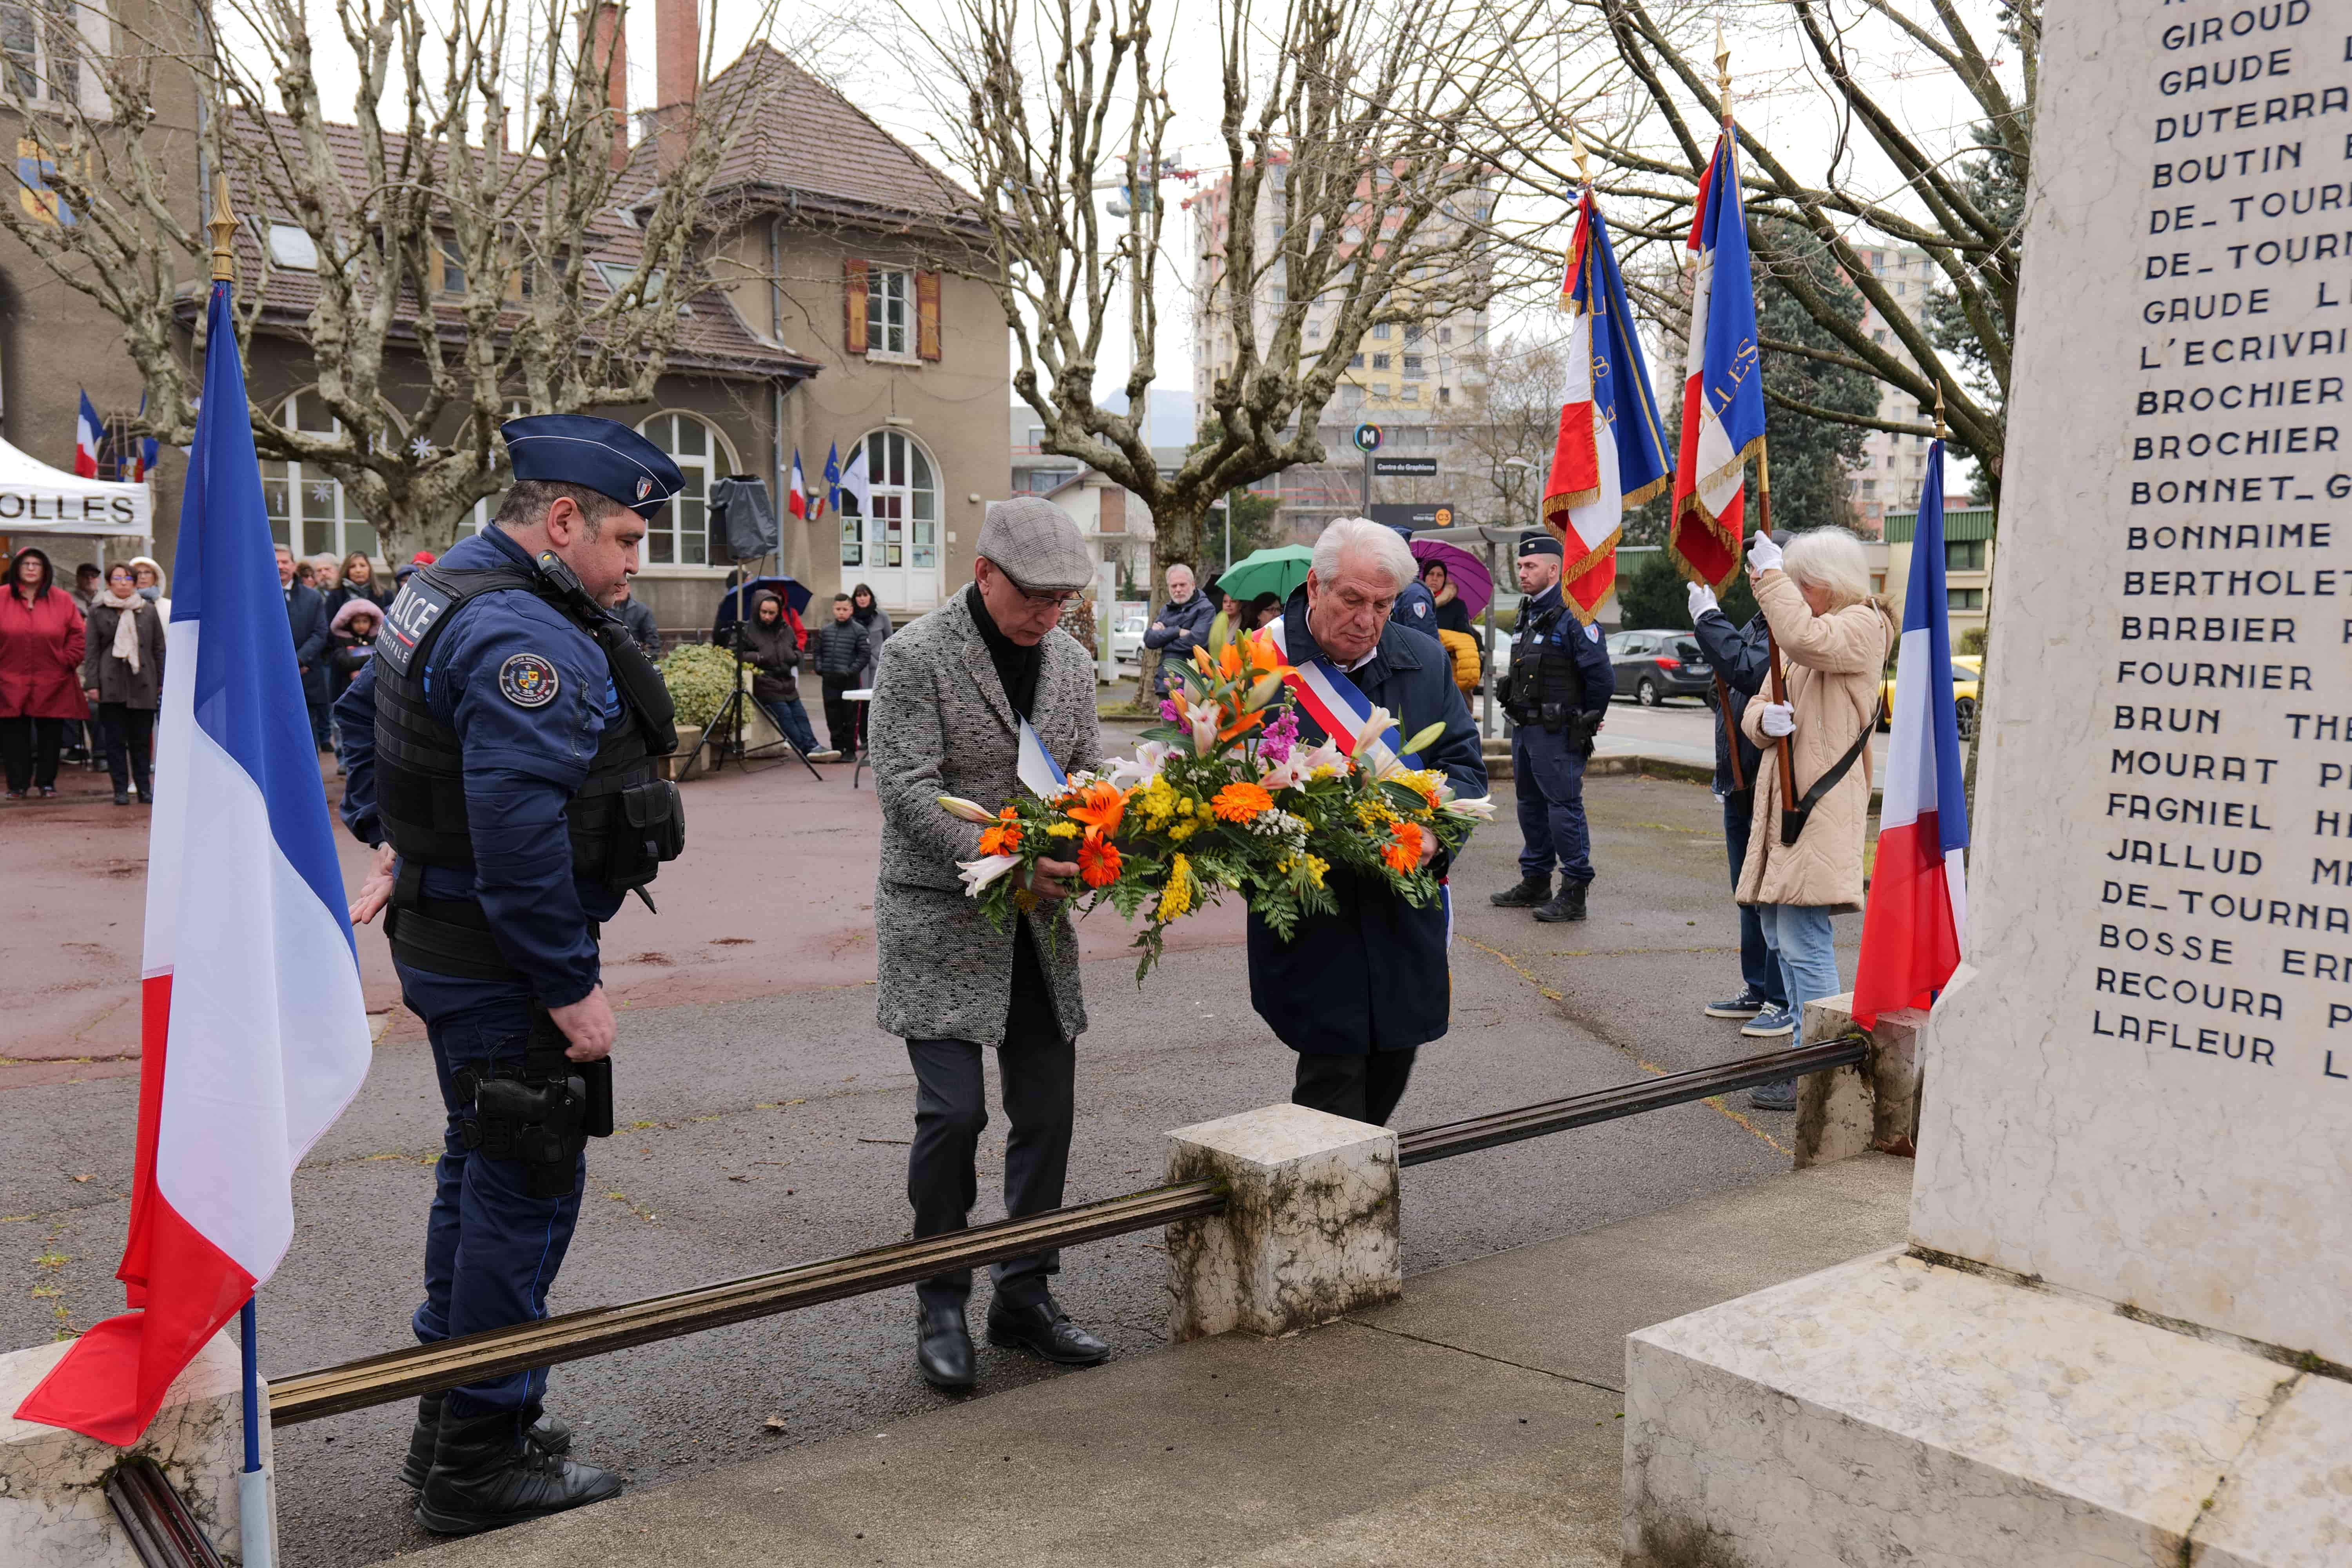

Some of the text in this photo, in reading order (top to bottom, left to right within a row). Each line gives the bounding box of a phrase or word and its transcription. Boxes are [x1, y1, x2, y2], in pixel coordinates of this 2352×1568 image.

[2162, 0, 2310, 51] GIROUD
[2159, 48, 2291, 96] GAUDE
[2154, 86, 2348, 143] DUTERRA
[2152, 142, 2301, 189] BOUTIN
[2143, 288, 2269, 325] GAUDE
[2140, 328, 2346, 370] L'ECRIVAI
[2136, 377, 2343, 416] BROCHIER
[1362, 430, 1375, 444] M
[2132, 426, 2339, 461] BROCHIER
[2127, 523, 2330, 550] BONNAIME
[389, 583, 439, 638] OLICE
[2121, 616, 2295, 643] BARBIER
[377, 624, 409, 663] UNICIPALE
[2117, 661, 2312, 691] FOURNIER
[2114, 705, 2220, 734] BRUN
[2111, 749, 2352, 790] MOURAT P
[2106, 793, 2352, 838] FAGNIEL H
[2106, 838, 2262, 876] JALLUD
[2100, 924, 2232, 965] BOSSE
[2096, 967, 2282, 1020] RECOURA
[2093, 1010, 2274, 1067] LAFLEUR
